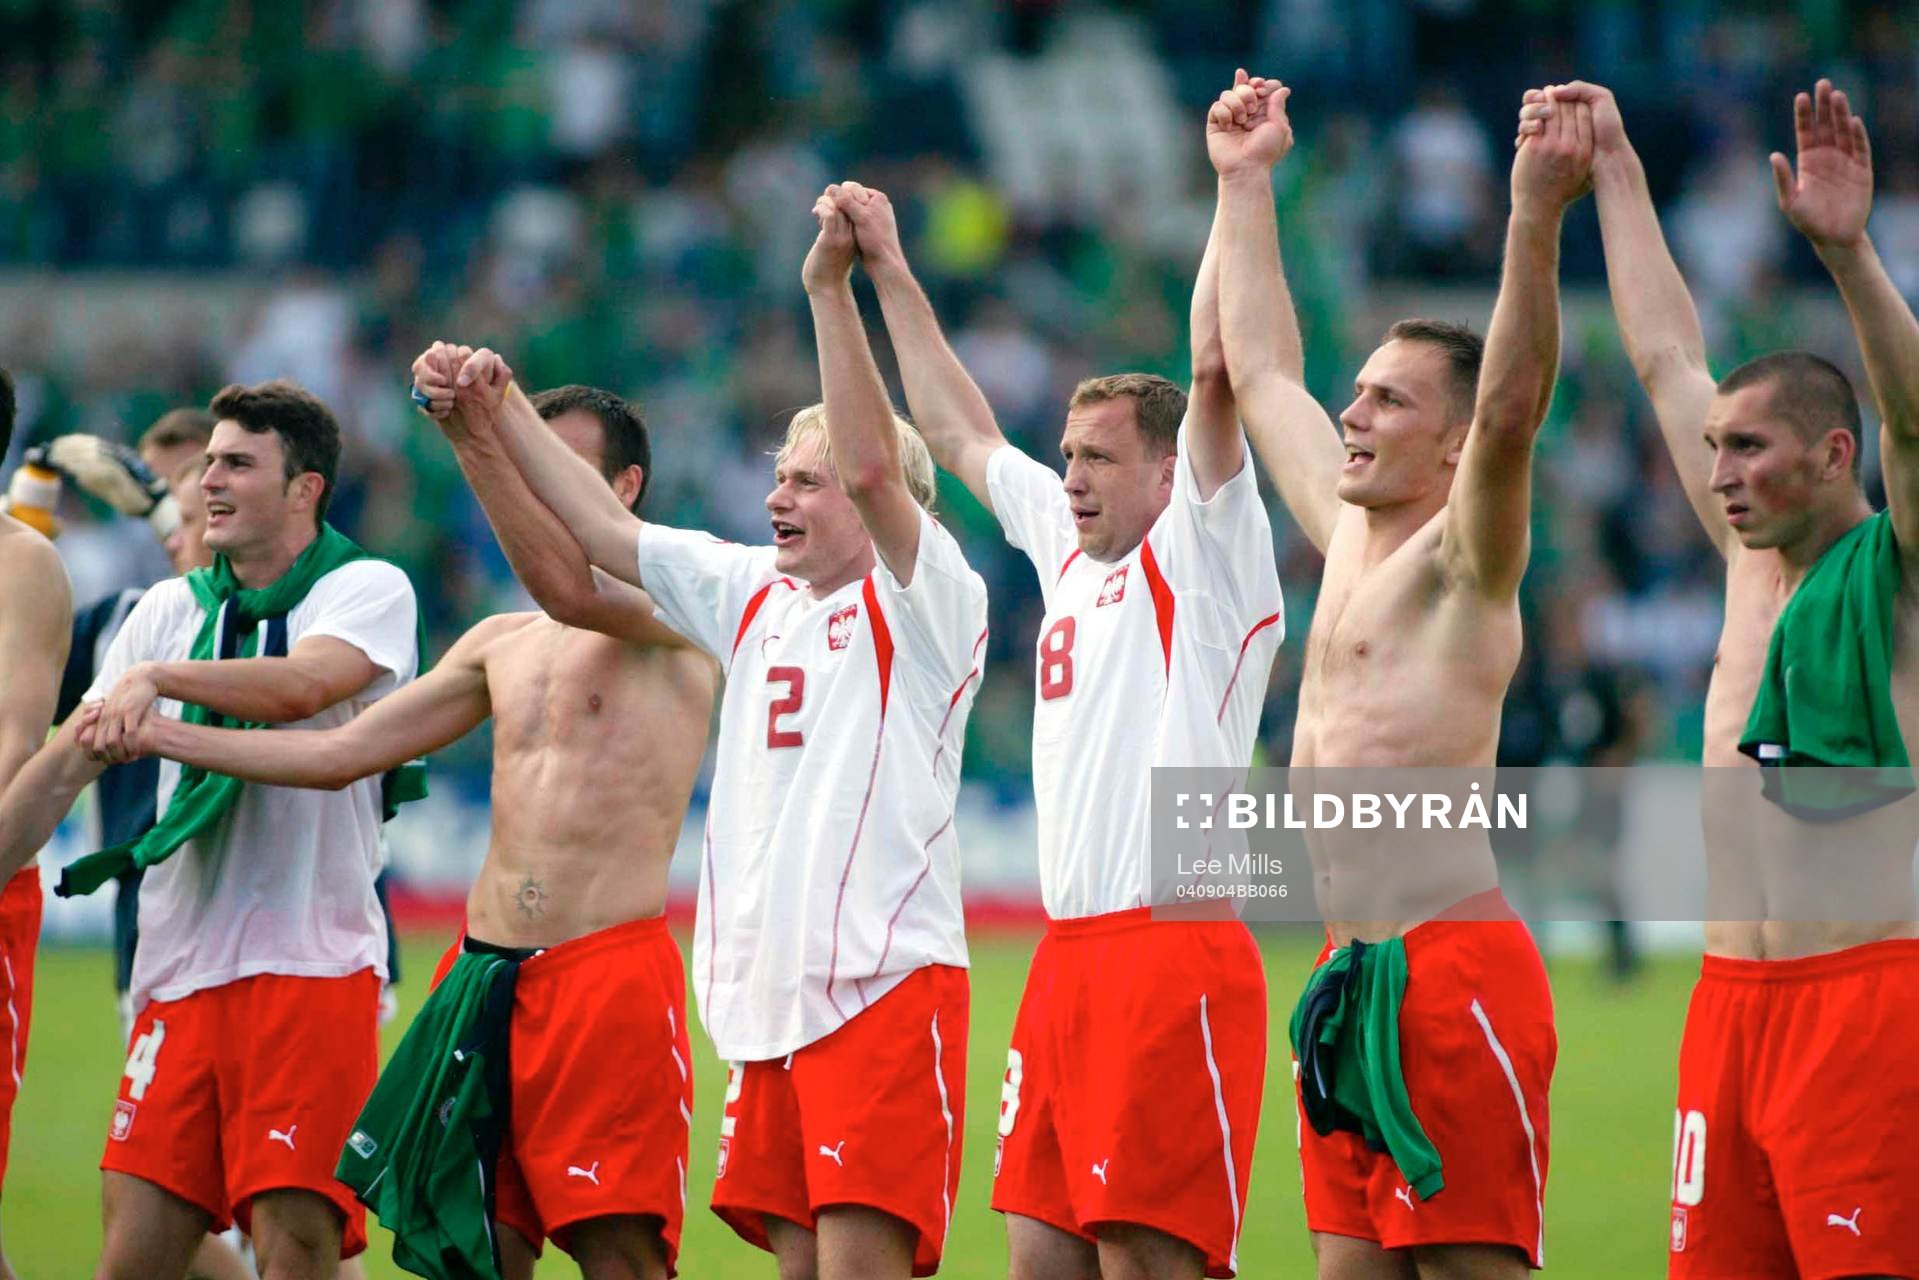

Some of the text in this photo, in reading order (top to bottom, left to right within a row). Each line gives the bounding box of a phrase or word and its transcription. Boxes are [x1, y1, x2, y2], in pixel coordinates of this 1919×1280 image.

[1040, 615, 1076, 701] 8
[766, 666, 806, 749] 2
[124, 1018, 166, 1101] 4
